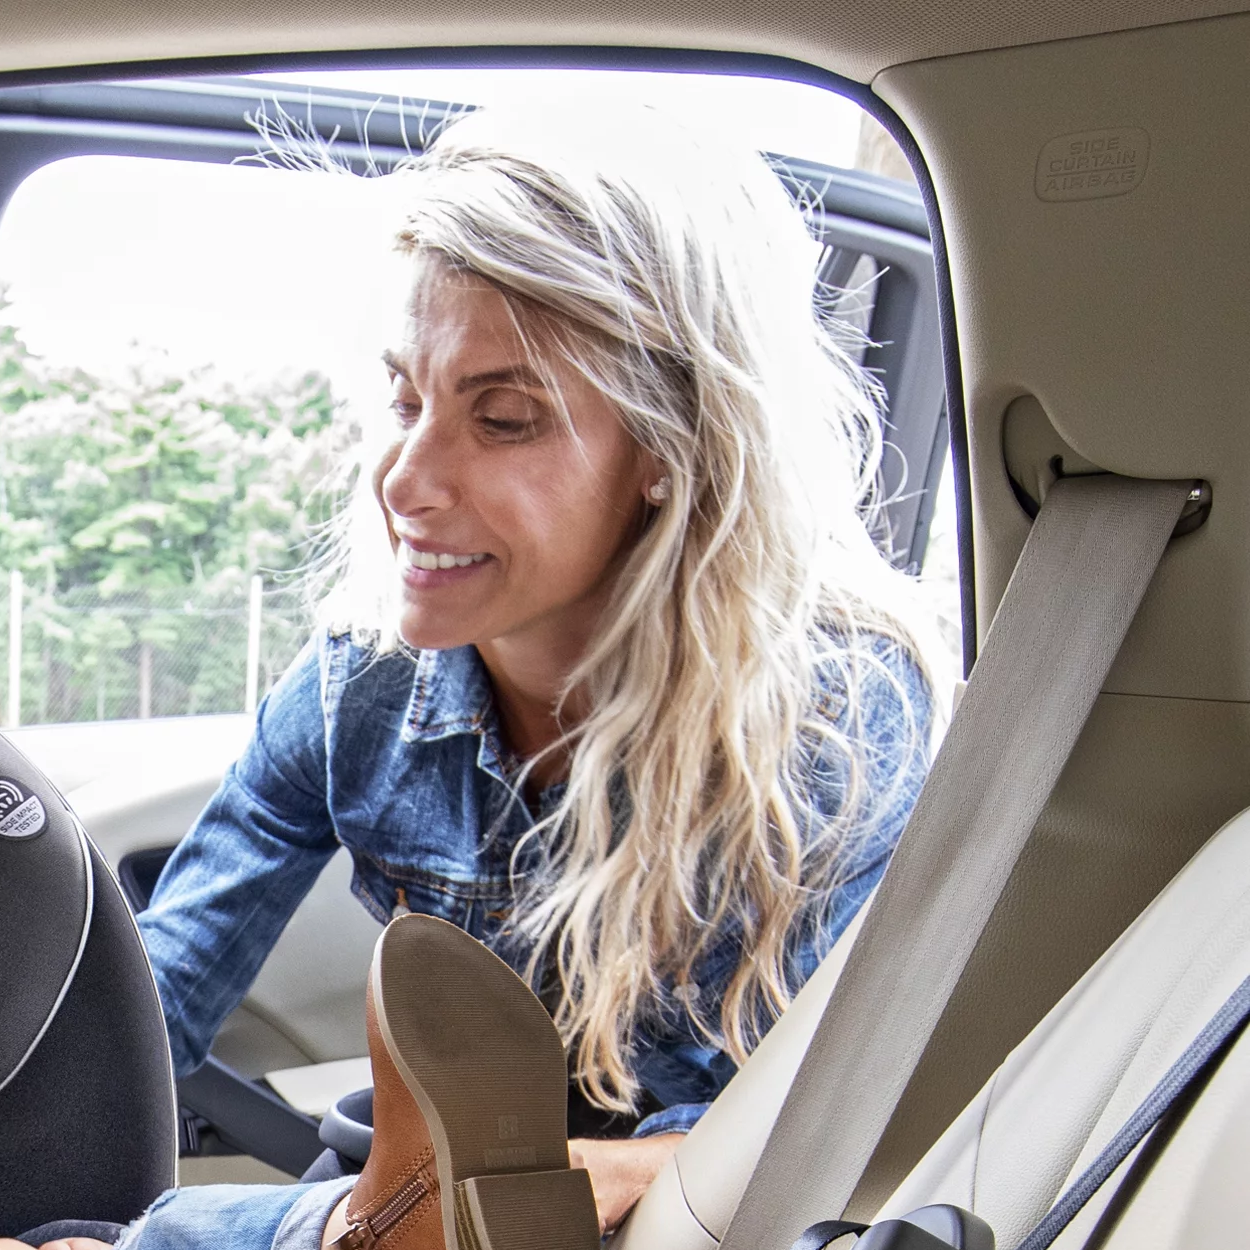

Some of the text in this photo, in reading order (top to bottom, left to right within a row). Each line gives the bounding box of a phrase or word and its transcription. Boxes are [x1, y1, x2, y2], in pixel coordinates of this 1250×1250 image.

[1070, 137, 1120, 155] SIDE
[1049, 150, 1136, 173] CURTAIN
[1044, 170, 1137, 192] AIRBAG
[0, 800, 39, 834] SIDE IMPACT
[14, 812, 41, 833] TESTED
